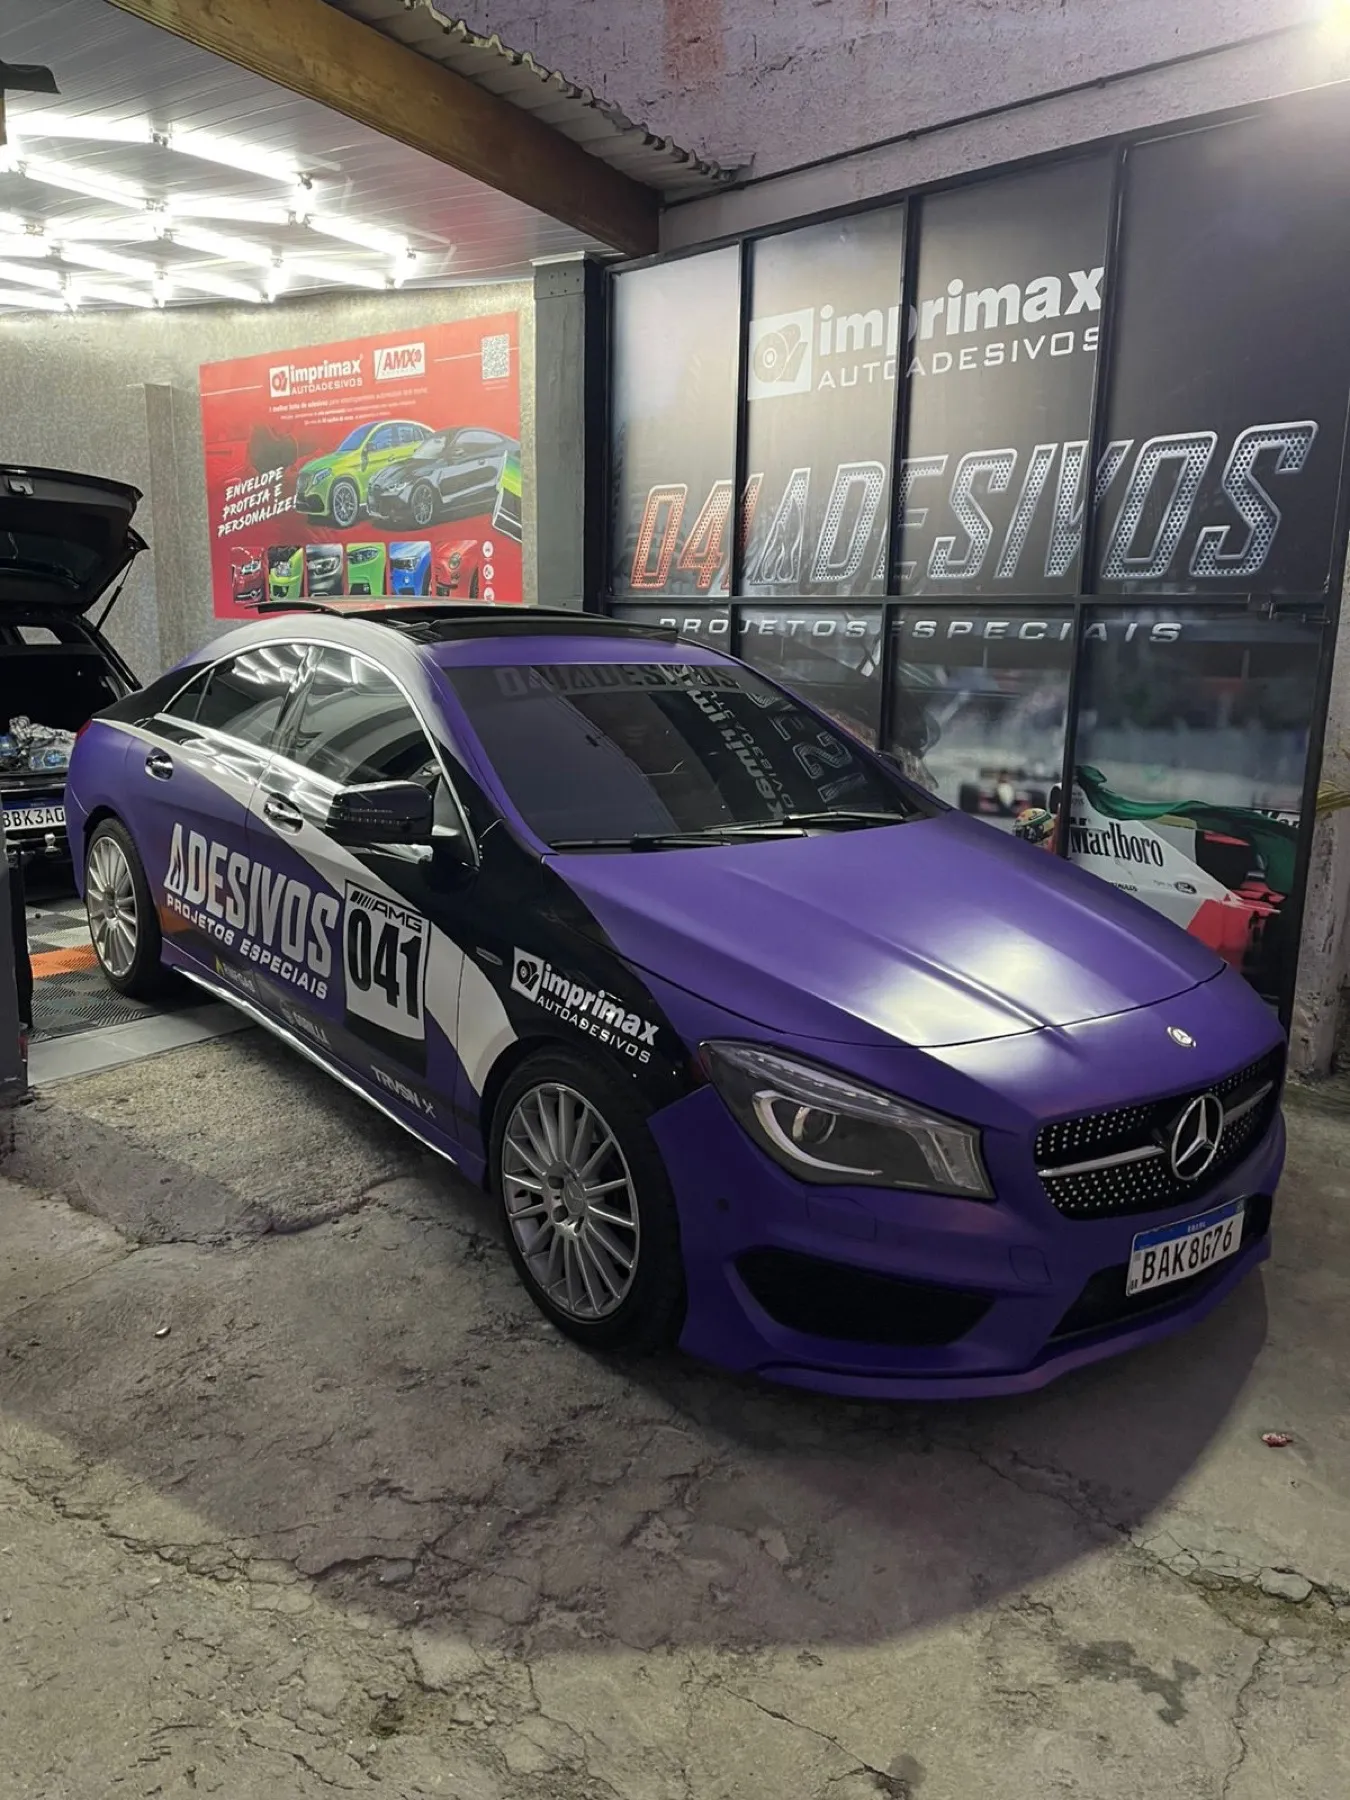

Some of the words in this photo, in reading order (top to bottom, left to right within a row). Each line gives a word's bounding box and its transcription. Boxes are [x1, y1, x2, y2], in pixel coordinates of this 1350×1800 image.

[819, 267, 1104, 356] imprimax
[290, 359, 361, 385] imprimax
[291, 378, 363, 395] AUTOADESIVOS
[223, 489, 270, 520] PROTEJA
[274, 484, 282, 497] E
[226, 467, 284, 501] ENVELOPE
[1070, 822, 1163, 867] Marlboro
[164, 823, 339, 979] ADESIVOS
[371, 900, 422, 934] AMG
[167, 897, 234, 946] PROJETOS
[240, 940, 327, 999] ESPECIAIS
[348, 909, 421, 1019] 041
[537, 996, 650, 1063] AUTOADESIVOS
[542, 964, 659, 1046] imprimax
[1142, 1221, 1233, 1284] BAK8G76
